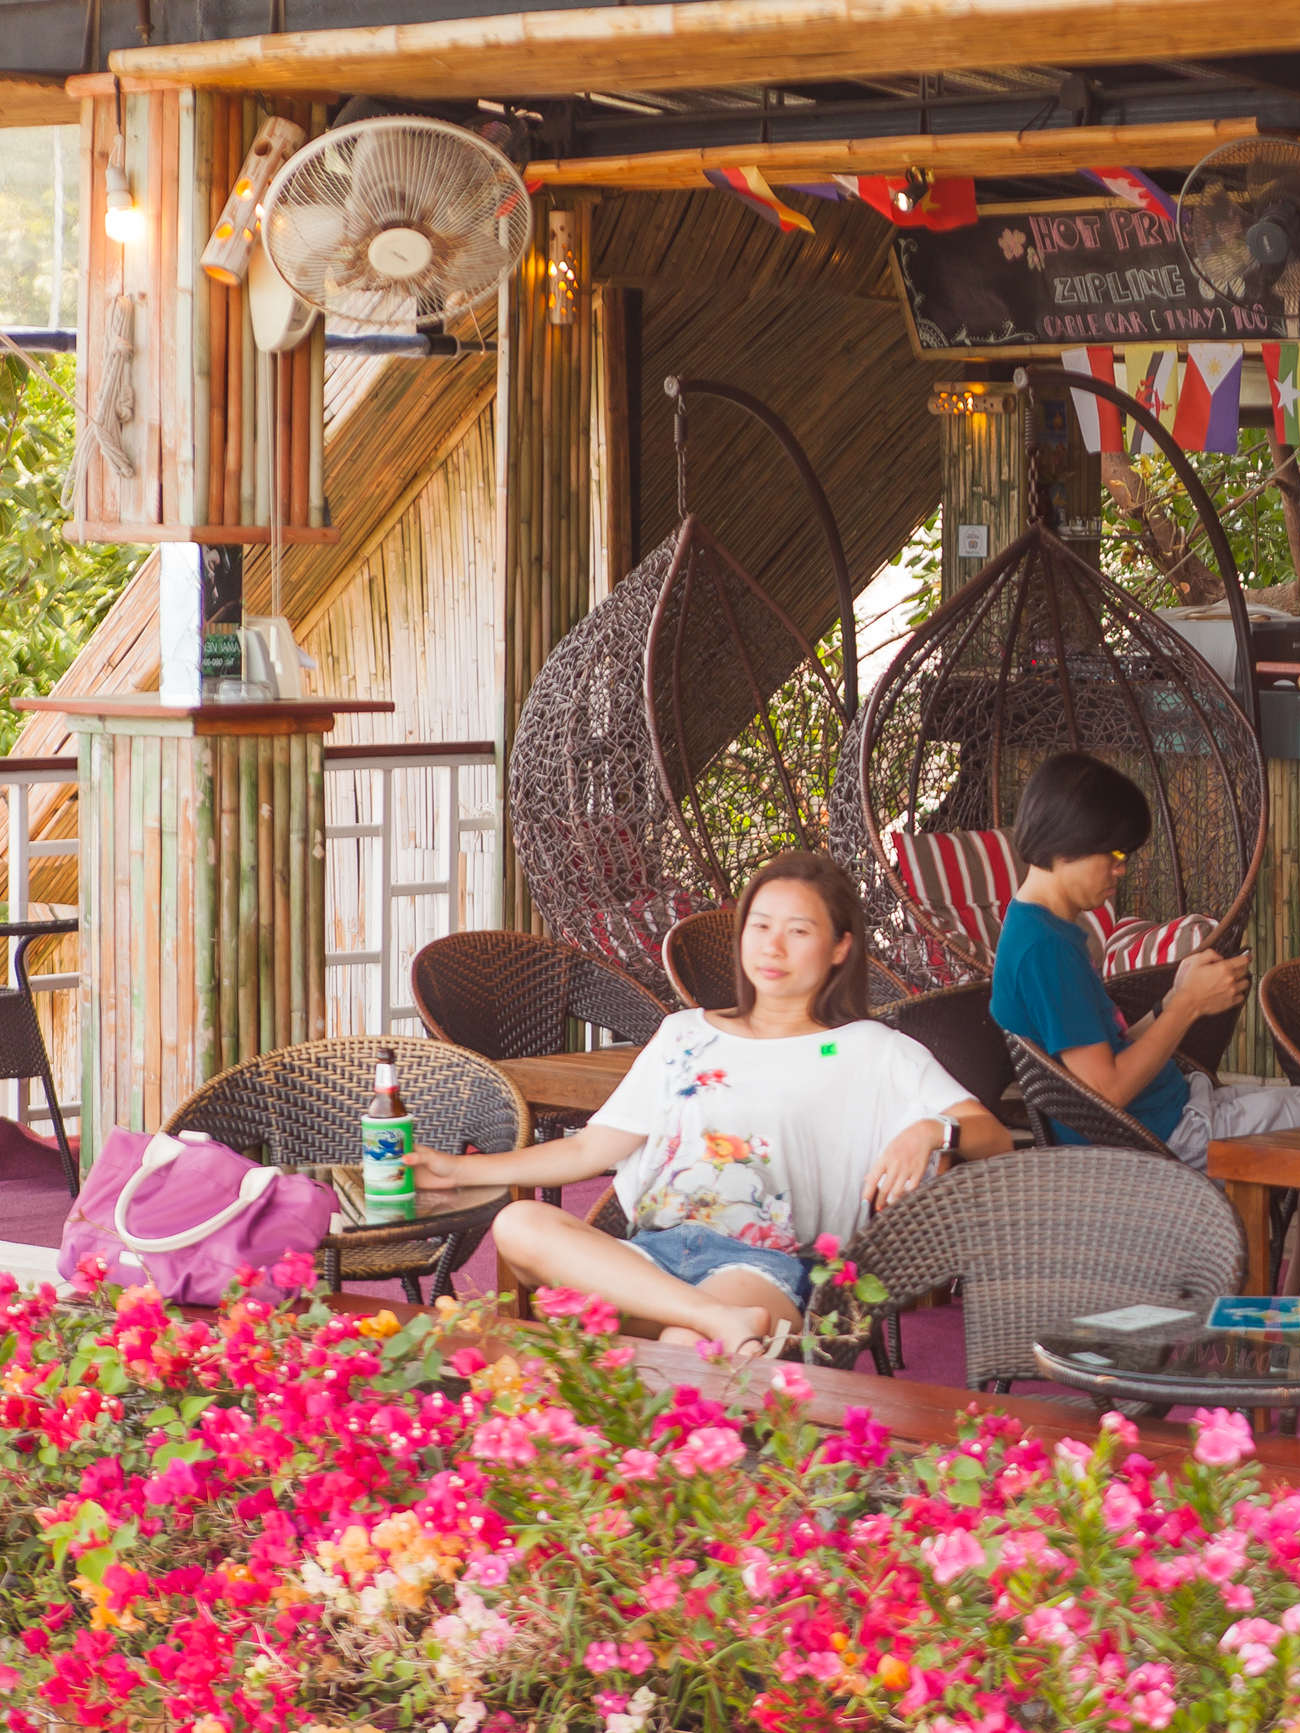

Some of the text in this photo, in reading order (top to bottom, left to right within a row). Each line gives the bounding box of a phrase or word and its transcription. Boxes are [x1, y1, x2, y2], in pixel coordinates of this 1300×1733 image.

[1029, 215, 1101, 252] HOT
[1054, 265, 1186, 303] ZIPLINE
[1043, 313, 1102, 338] CABLE
[1105, 309, 1148, 334] CAR
[1231, 303, 1268, 331] 100
